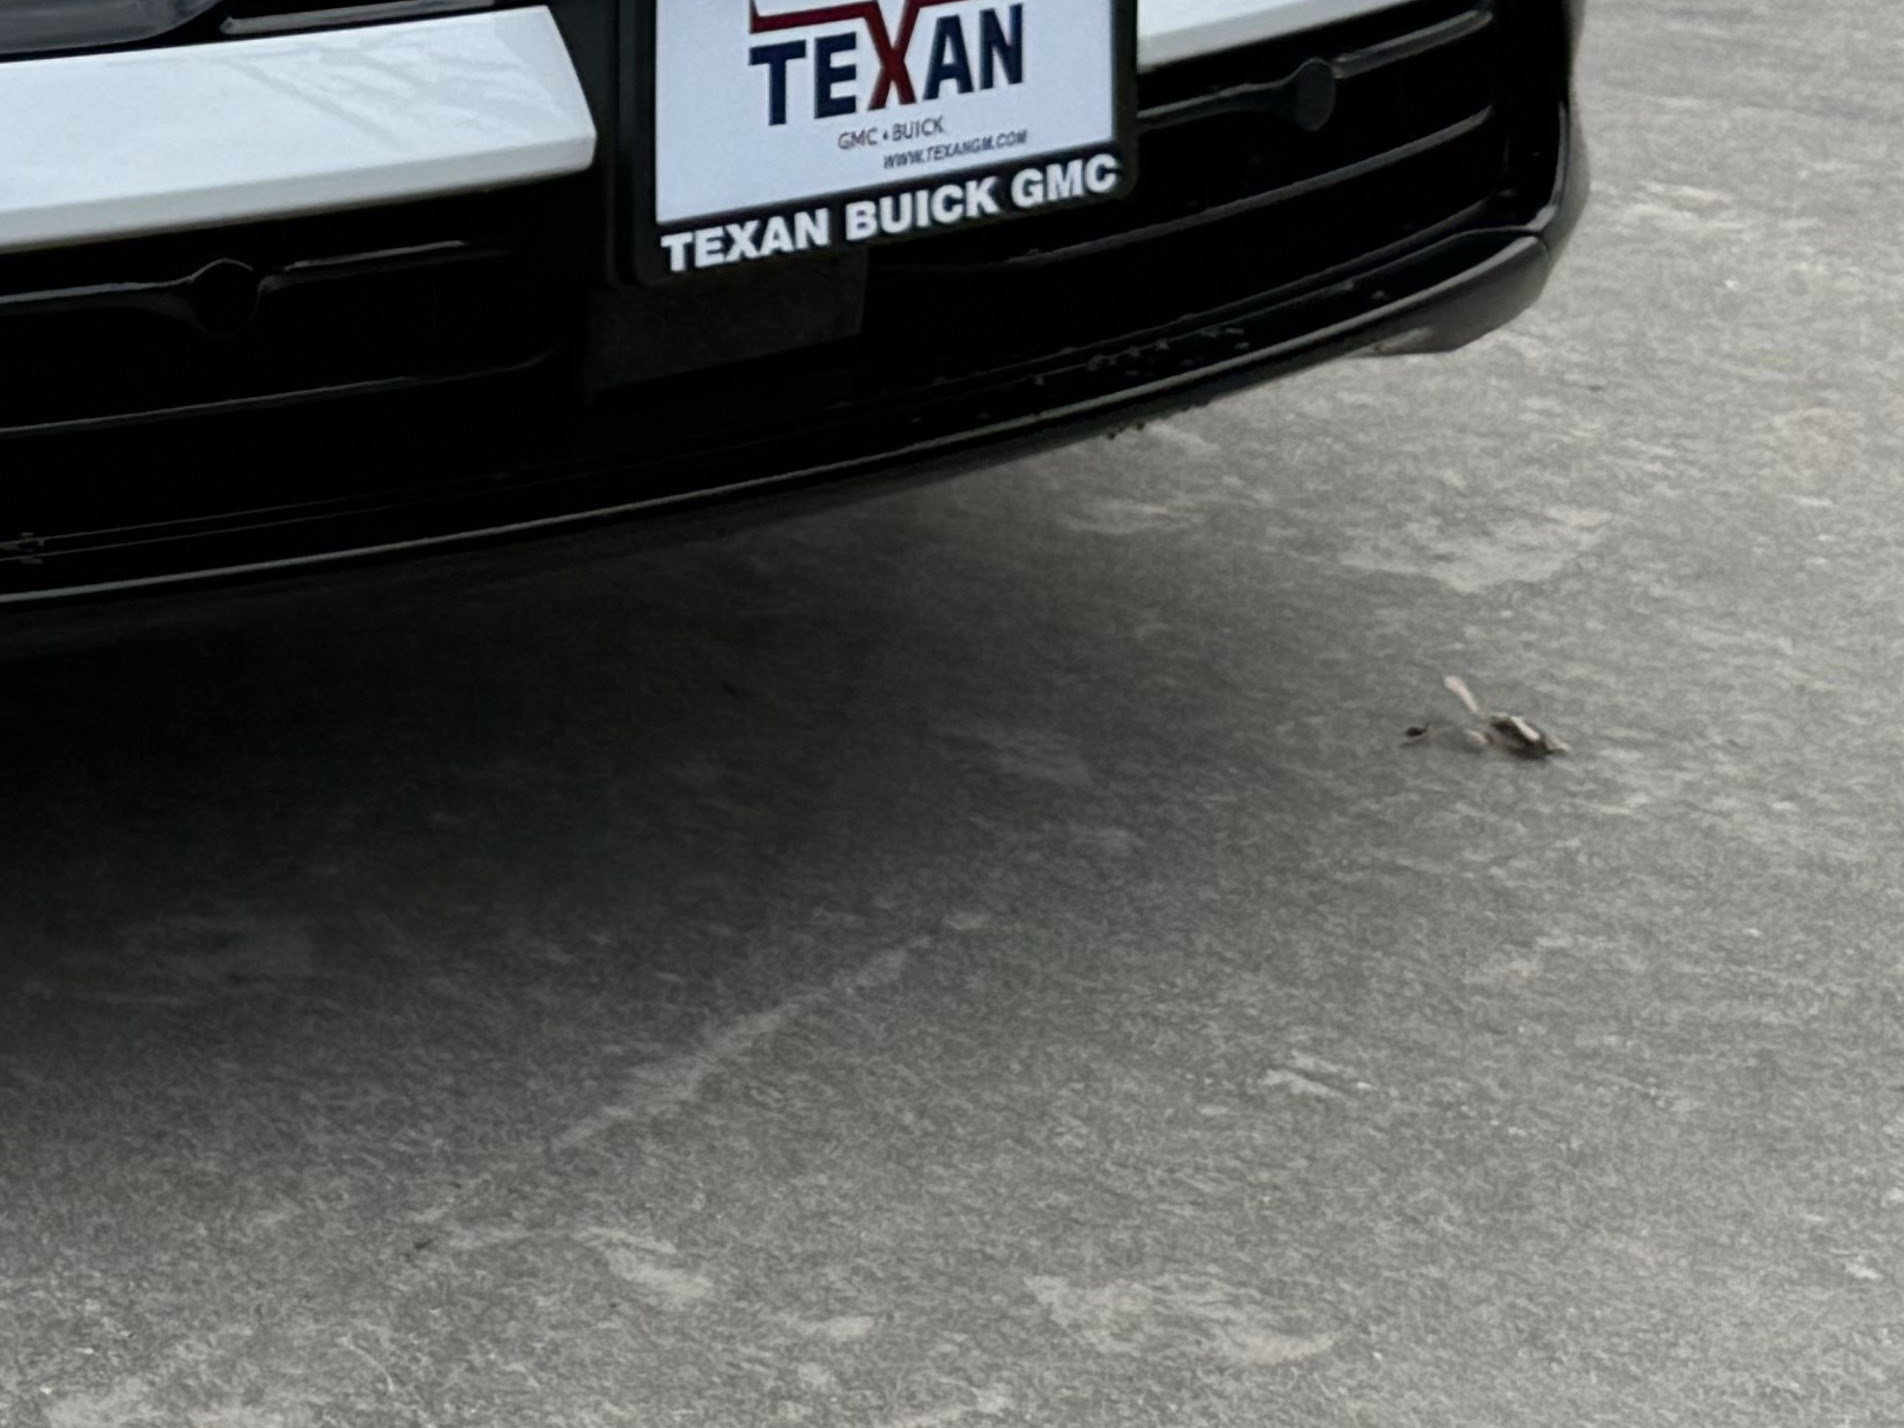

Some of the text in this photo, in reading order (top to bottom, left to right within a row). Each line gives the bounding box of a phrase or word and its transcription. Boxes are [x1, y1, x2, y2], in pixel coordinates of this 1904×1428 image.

[837, 116, 946, 151] GMC BUICK
[660, 153, 1121, 274] TEXAN BUICK GMC
